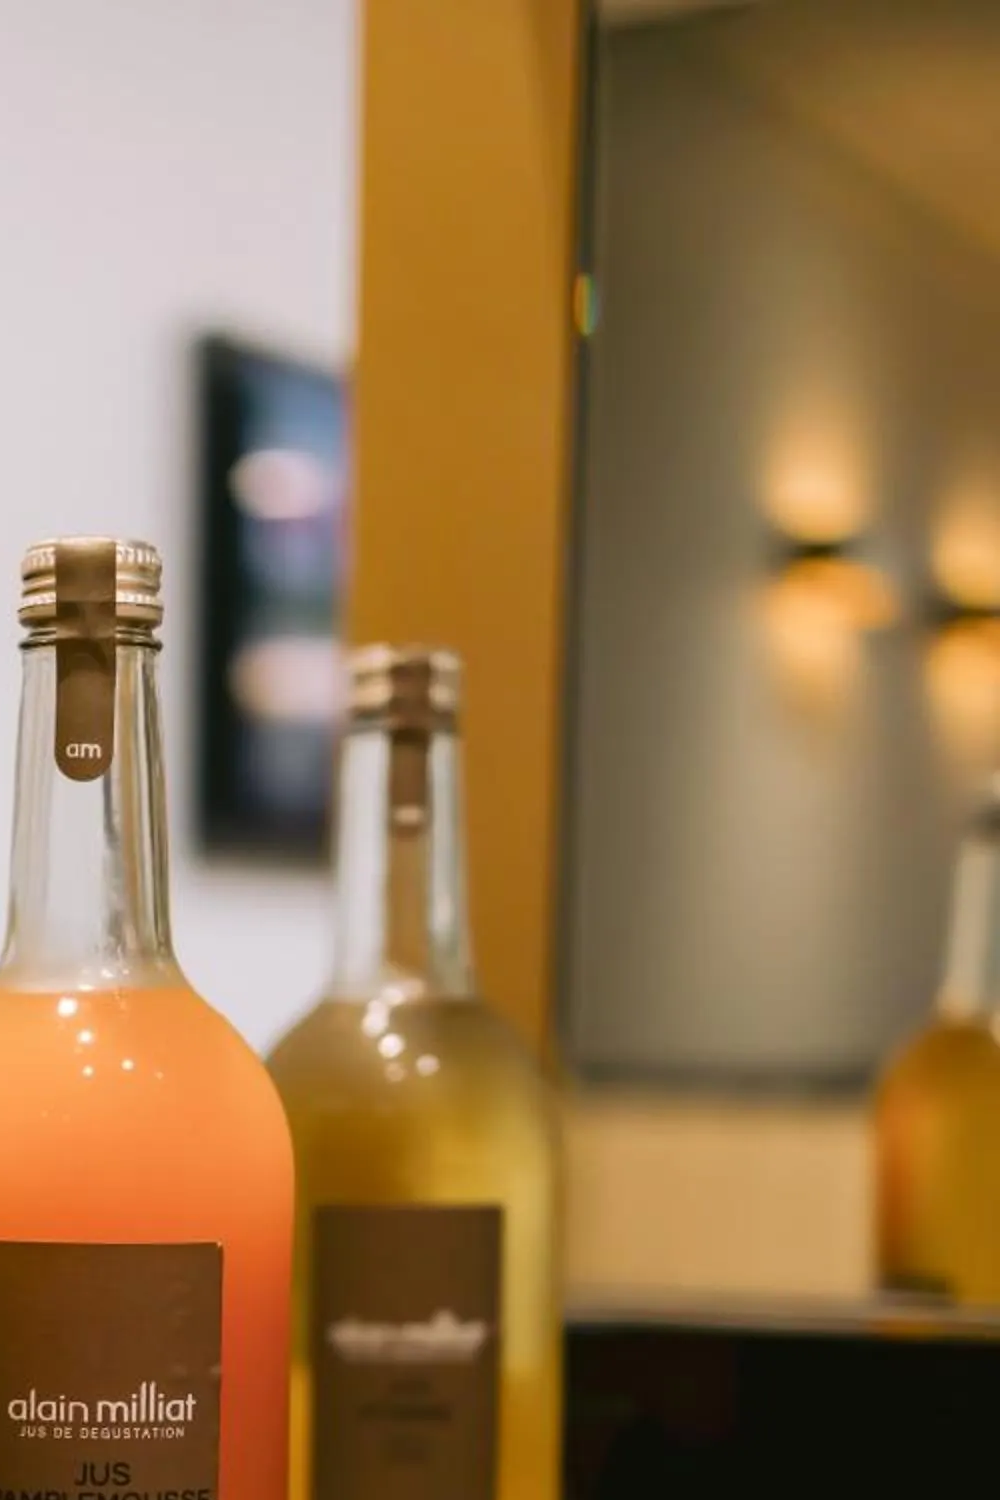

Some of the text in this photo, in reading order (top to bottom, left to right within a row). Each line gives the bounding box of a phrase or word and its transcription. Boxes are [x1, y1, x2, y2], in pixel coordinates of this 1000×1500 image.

[66, 743, 102, 759] am
[7, 1380, 197, 1423] alain milliat
[20, 1427, 186, 1440] JUS DE DEGUSTATION
[74, 1462, 132, 1487] JUS
